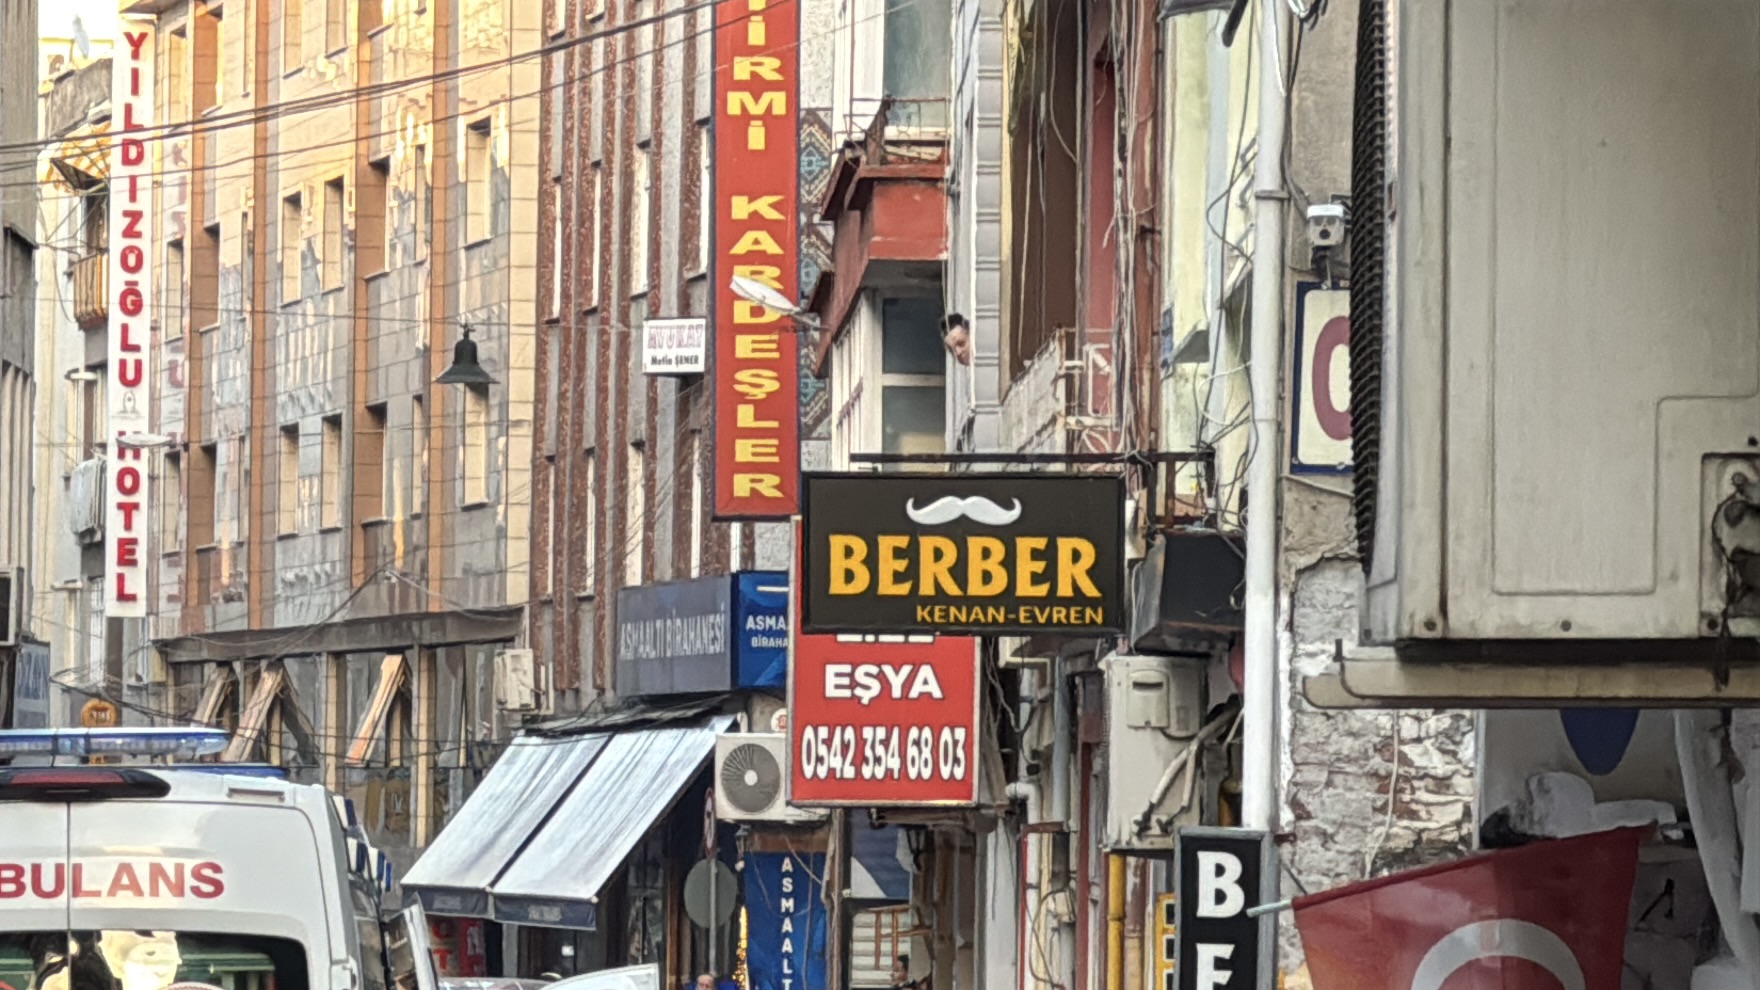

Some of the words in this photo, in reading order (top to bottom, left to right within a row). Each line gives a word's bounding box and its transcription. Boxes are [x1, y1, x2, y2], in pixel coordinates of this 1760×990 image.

[726, 0, 787, 151] İRMİ
[119, 31, 149, 389] YILDIZOĞLU
[729, 195, 786, 498] KARDEŞLER
[115, 430, 143, 602] HOTEL
[828, 533, 1103, 598] BERBER
[745, 614, 789, 631] ASMA
[915, 604, 1104, 625] KENAN-EVREN
[824, 663, 944, 706] EŞYA
[801, 724, 857, 780] 0542
[861, 725, 902, 781] 354
[906, 725, 934, 781] 68
[938, 726, 967, 781] 03
